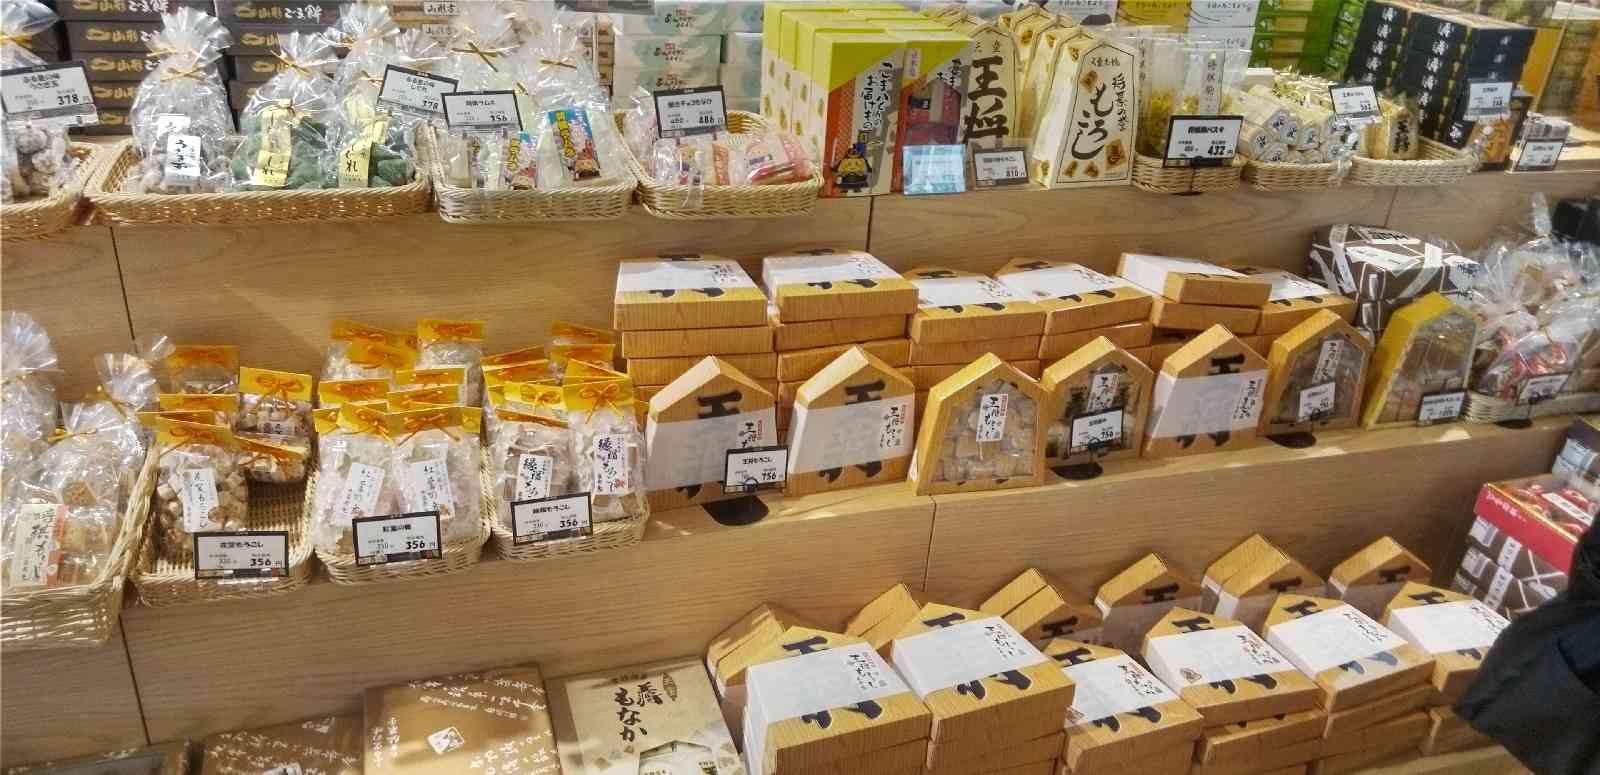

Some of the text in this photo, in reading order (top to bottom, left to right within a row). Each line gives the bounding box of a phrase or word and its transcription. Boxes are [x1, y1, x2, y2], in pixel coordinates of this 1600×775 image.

[57, 94, 80, 106] 378
[963, 55, 1010, 149] 王将
[489, 115, 508, 123] 356
[698, 115, 715, 124] 486
[1070, 82, 1115, 160] もろこし
[1207, 144, 1226, 156] 432
[761, 471, 777, 481] 756
[559, 518, 578, 529] 356
[405, 540, 426, 550] 356
[249, 557, 272, 567] 356
[614, 686, 648, 742] もなか
